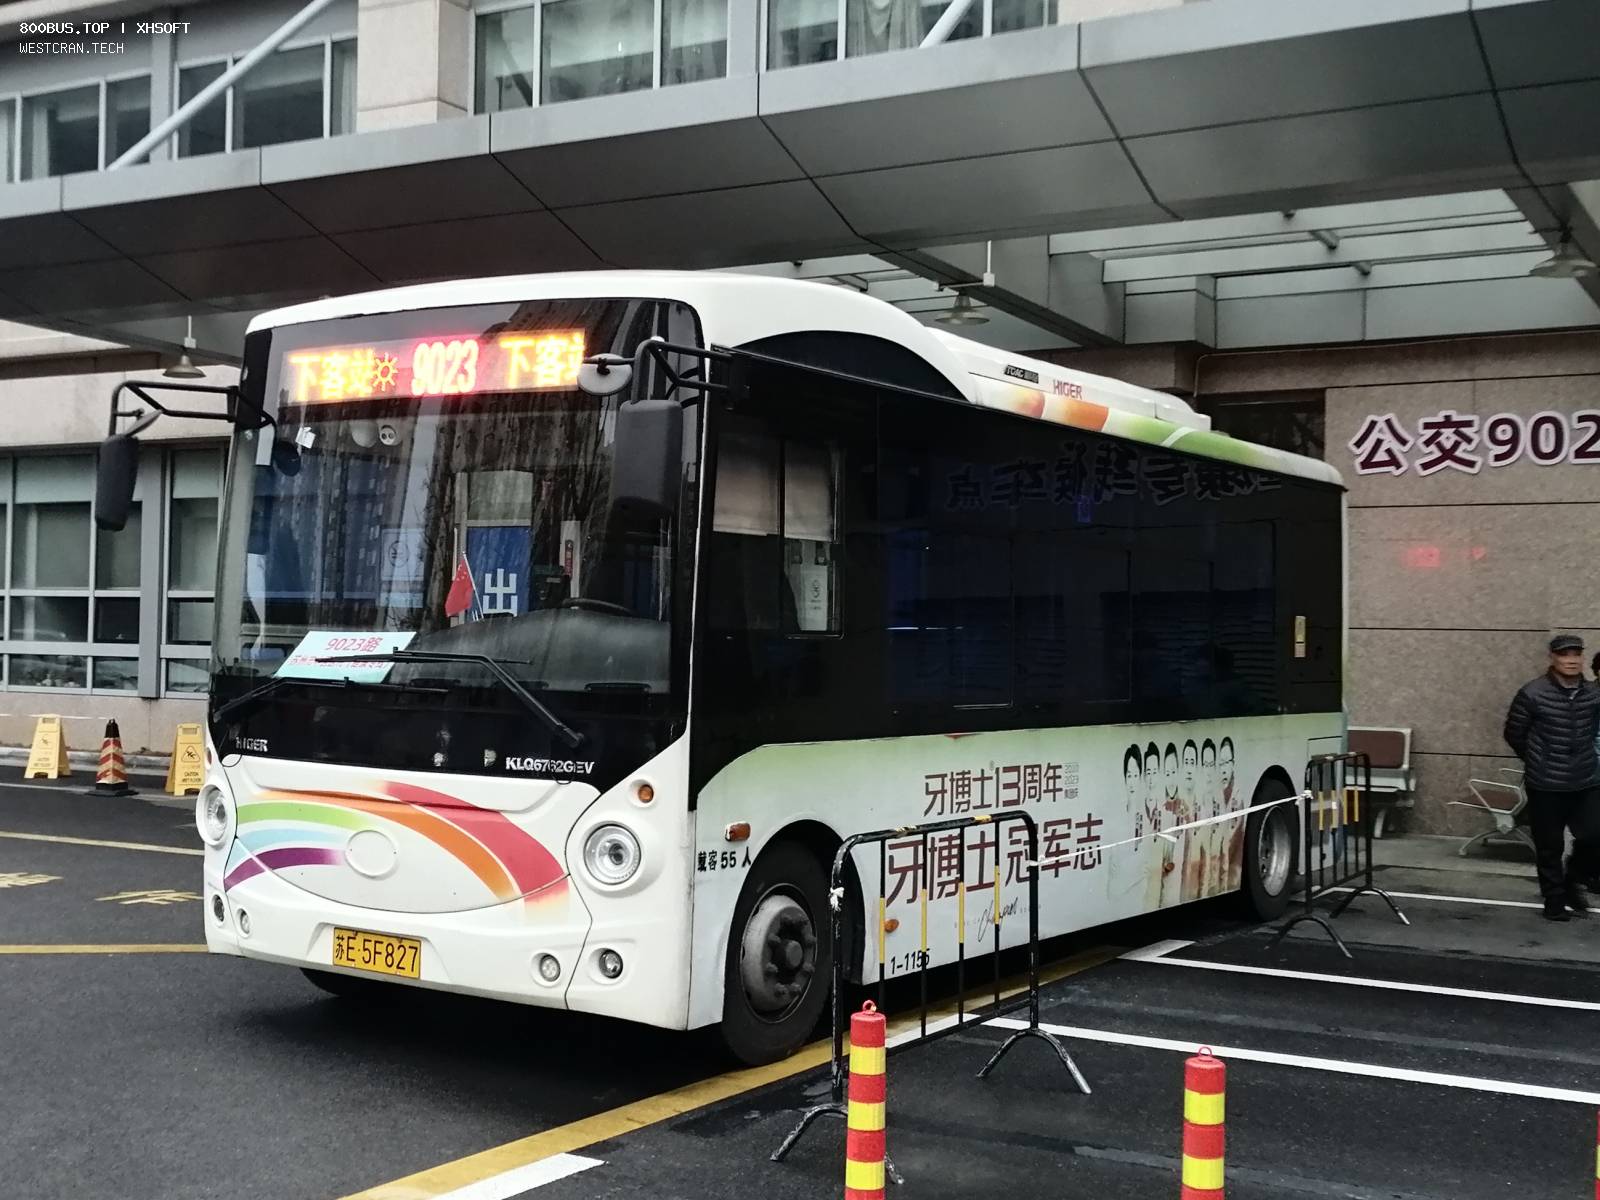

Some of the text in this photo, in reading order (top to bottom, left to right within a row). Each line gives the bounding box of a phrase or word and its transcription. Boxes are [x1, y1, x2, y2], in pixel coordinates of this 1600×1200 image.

[411, 339, 479, 397] 9023
[1053, 378, 1083, 400] HIGER
[1349, 410, 1600, 476] 公交902
[482, 567, 518, 618] 出
[325, 636, 384, 653] 9023路
[235, 736, 268, 752] HIGER
[923, 761, 1064, 818] 牙博士13周年
[741, 845, 752, 868] 人
